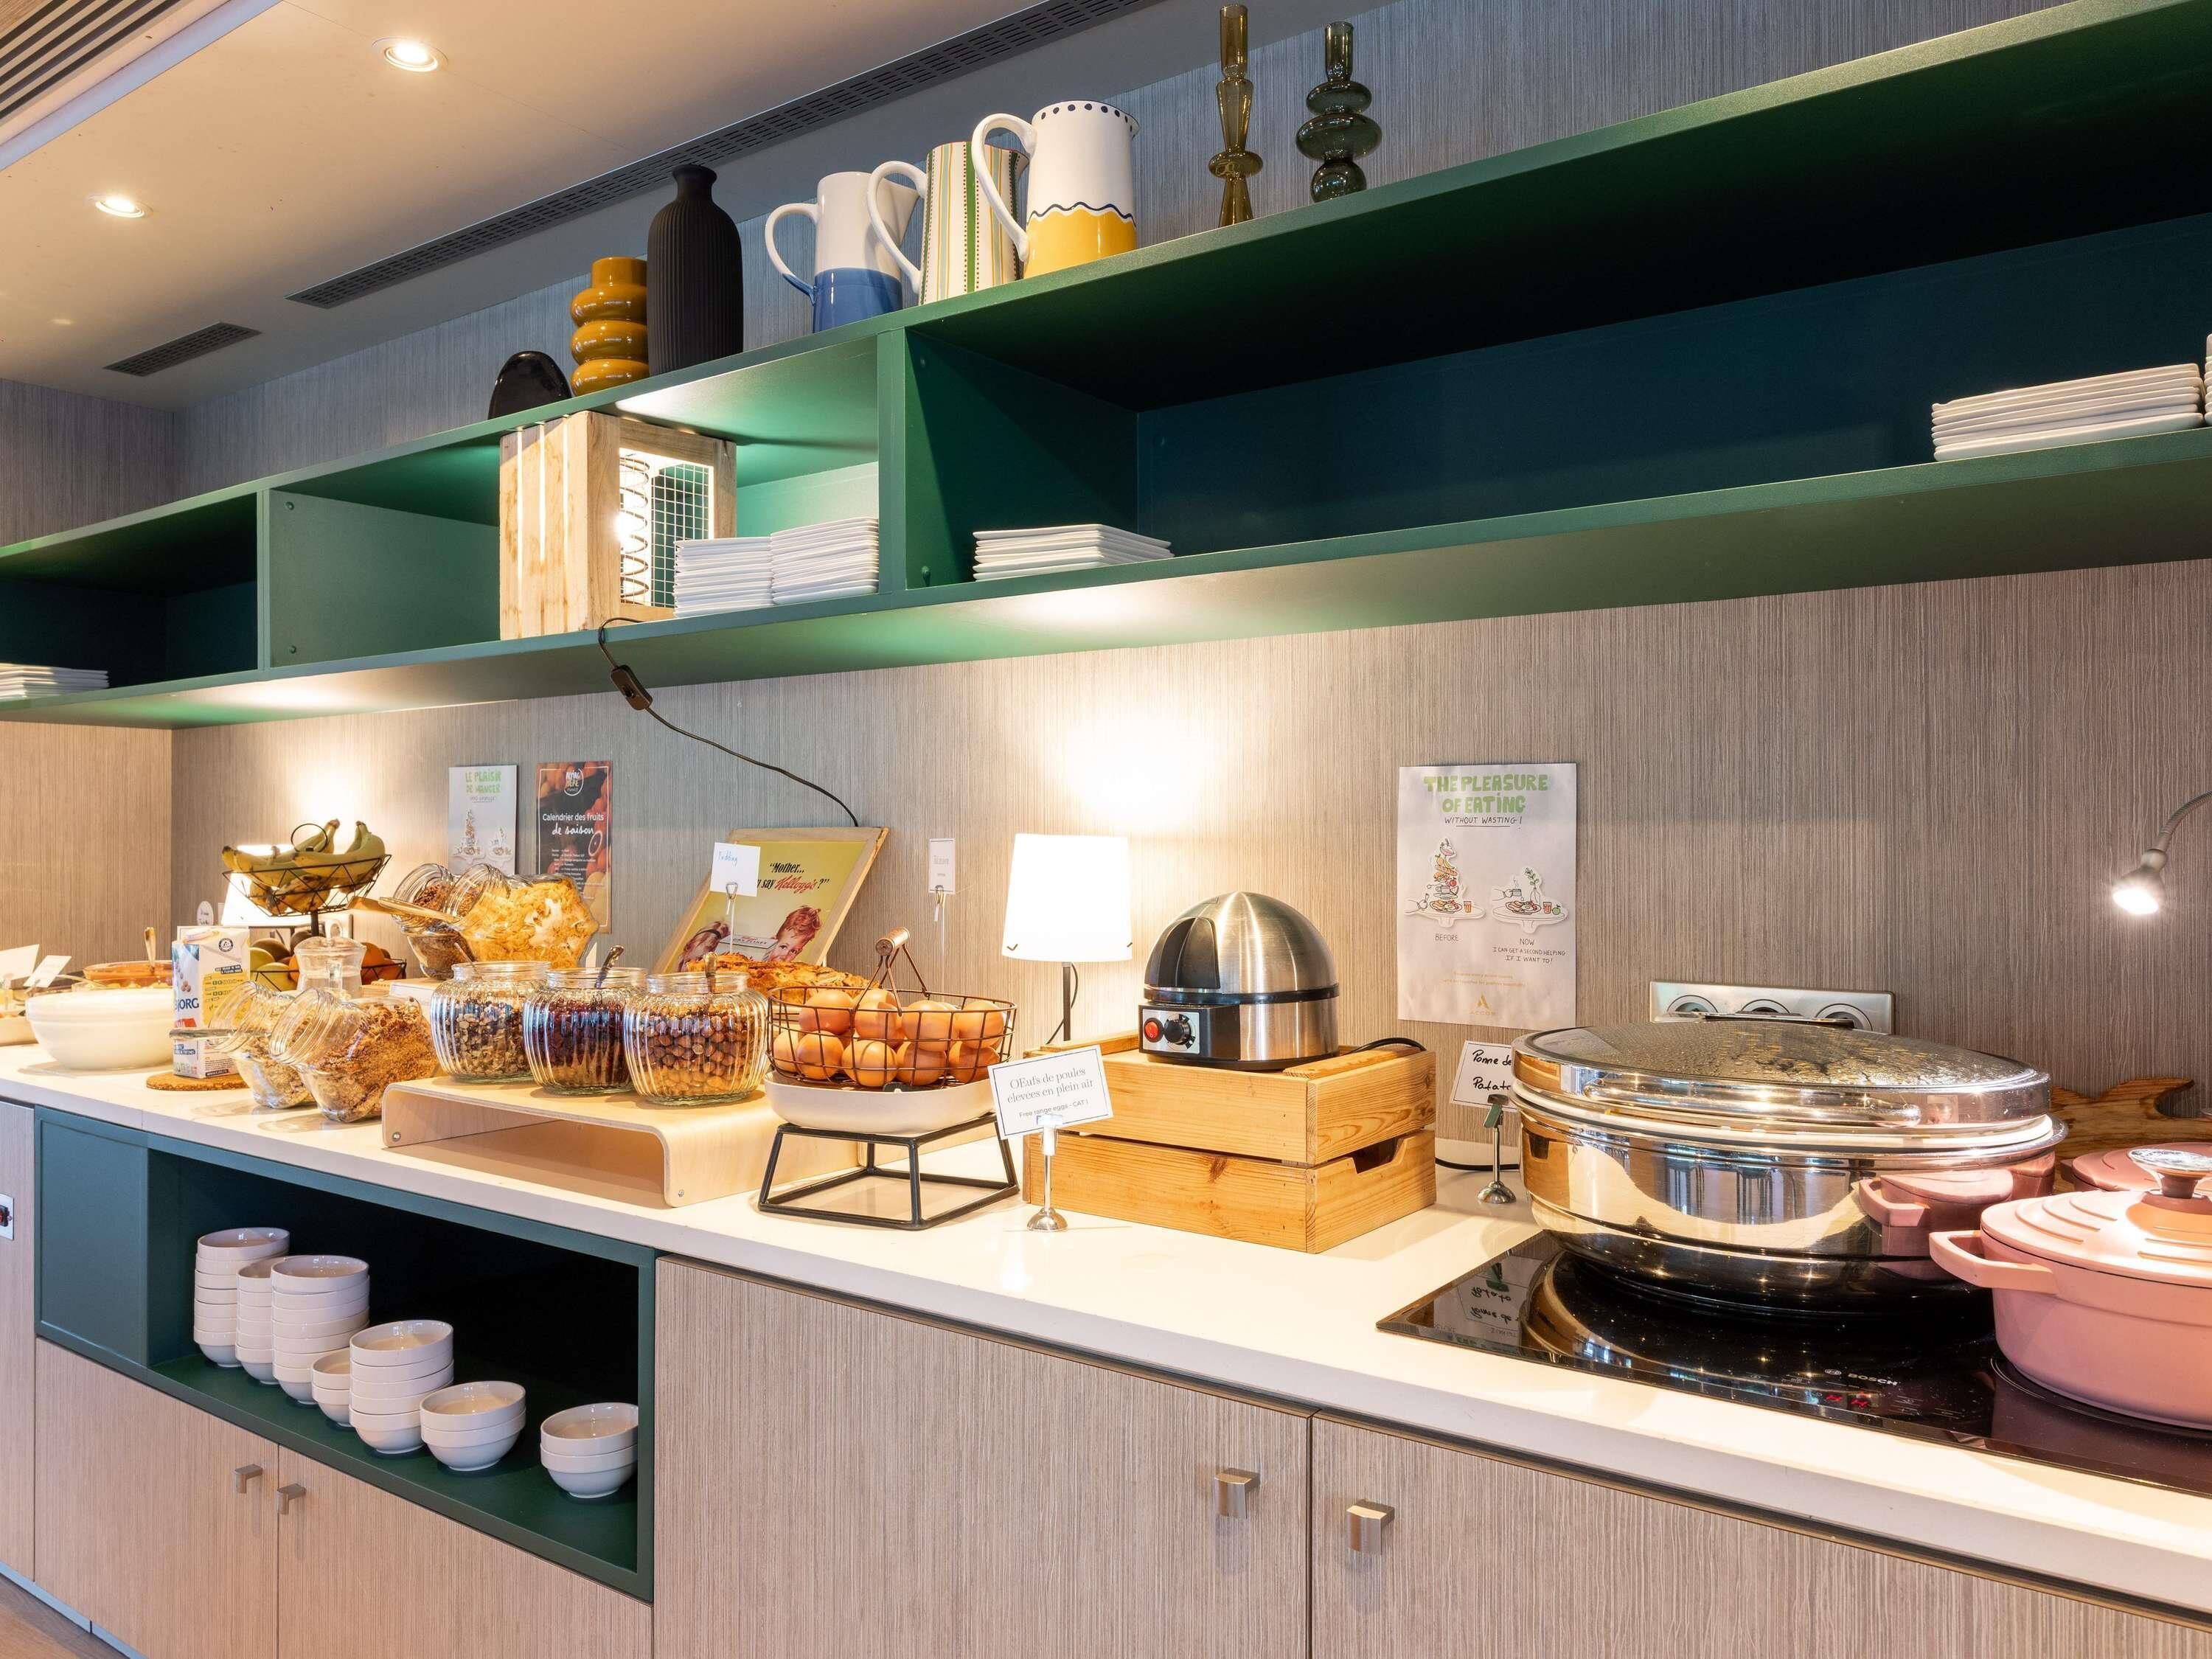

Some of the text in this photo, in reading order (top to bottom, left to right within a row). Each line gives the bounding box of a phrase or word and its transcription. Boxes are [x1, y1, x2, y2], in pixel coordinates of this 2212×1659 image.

[1424, 773, 1548, 793] THE PLEASURE
[1442, 797, 1461, 813] OF
[542, 813, 605, 821] Calendrier des fruits
[1444, 815, 1478, 824] WITHOUT
[552, 822, 594, 835] de saison
[761, 878, 776, 889] say
[1435, 933, 1459, 942] BEFORE
[1519, 938, 1535, 946] NOW
[1043, 1074, 1055, 1084] de
[1056, 1068, 1086, 1084] poules
[1041, 1088, 1054, 1096] en
[1056, 1080, 1079, 1097] plein
[1082, 1079, 1093, 1088] air
[1034, 1107, 1052, 1116] range
[1053, 1103, 1068, 1112] eggs
[1848, 1372, 1898, 1387] BOSCH
